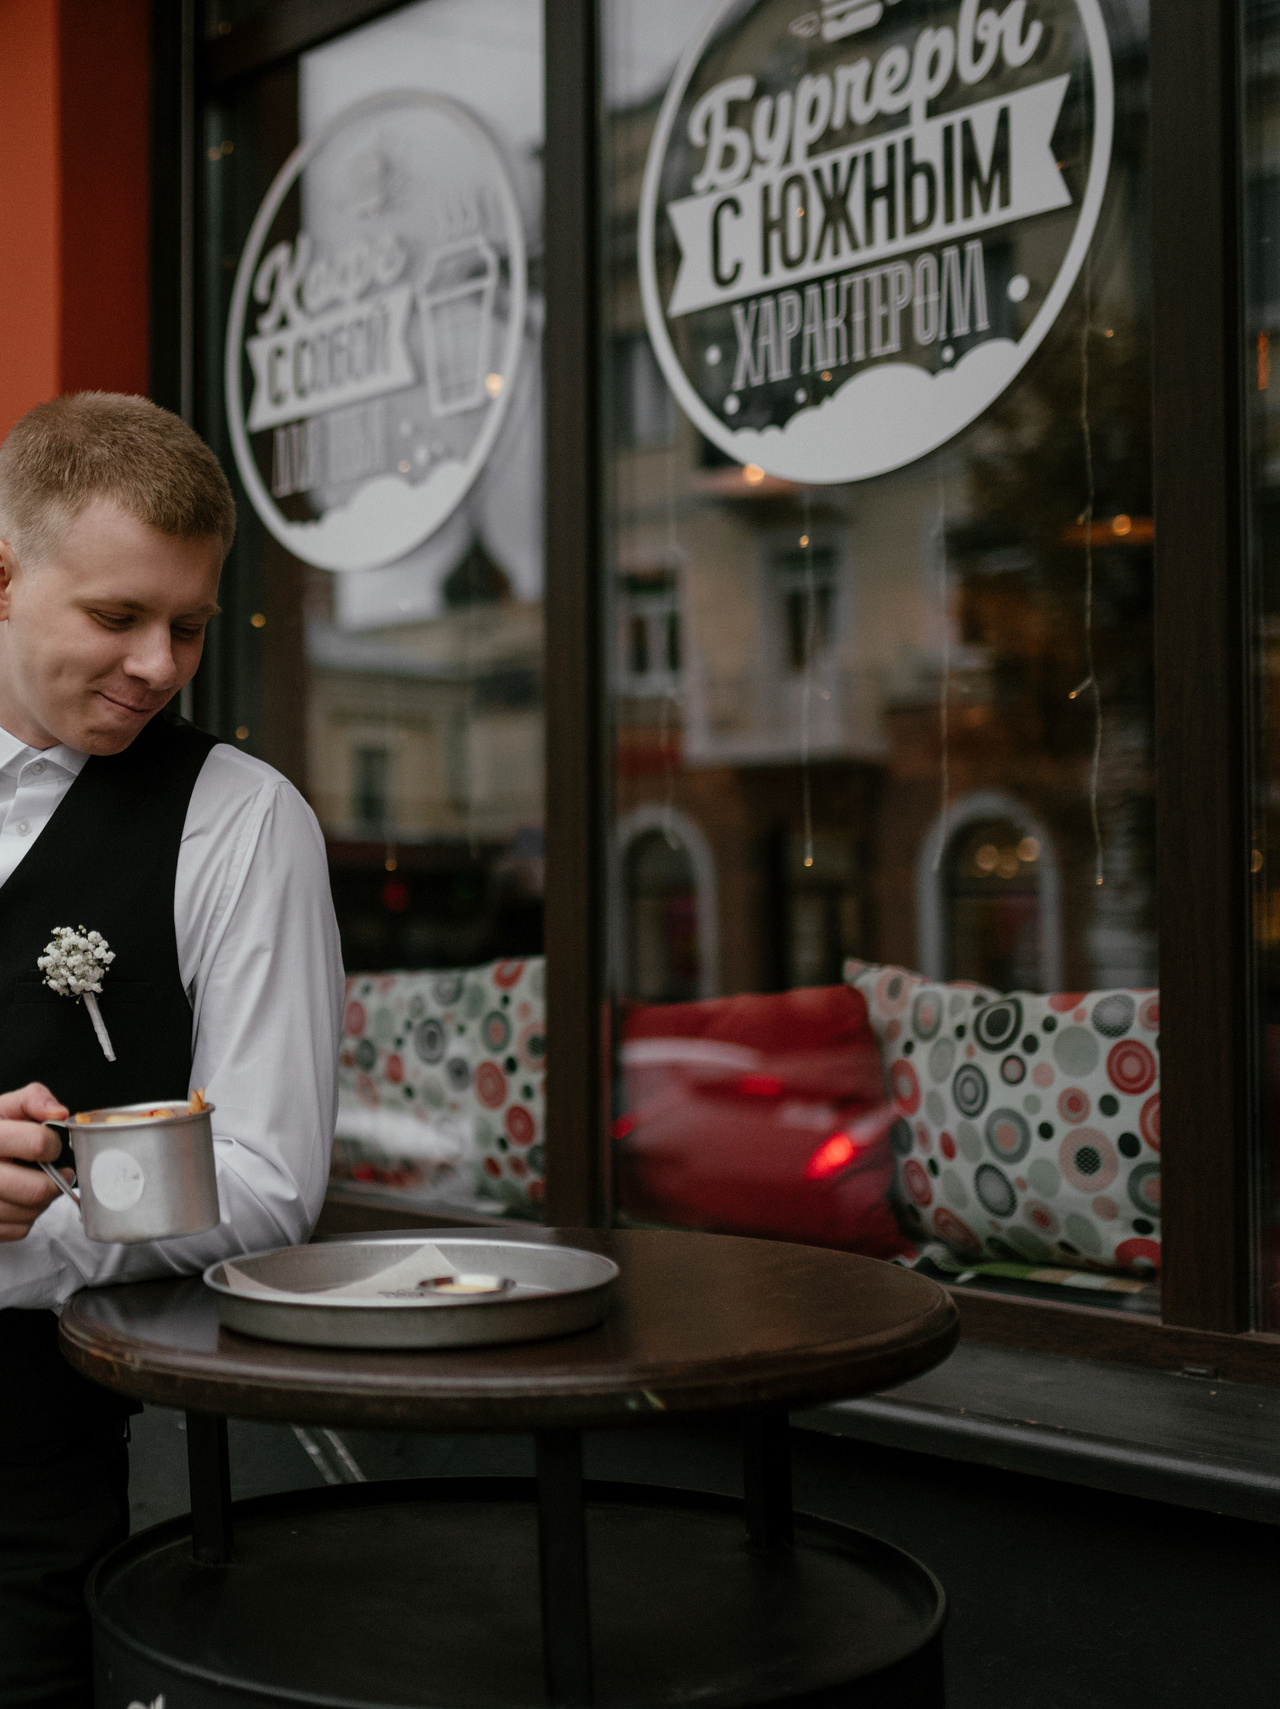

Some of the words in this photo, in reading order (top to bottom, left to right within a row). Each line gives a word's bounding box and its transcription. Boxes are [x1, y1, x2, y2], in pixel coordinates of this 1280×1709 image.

[687, 0, 1043, 195] Бургеры
[710, 196, 742, 288] С
[760, 103, 1012, 278] ЮЖНЫМ
[267, 345, 287, 408] С
[730, 238, 991, 392] ХАРАКТЕРОМ
